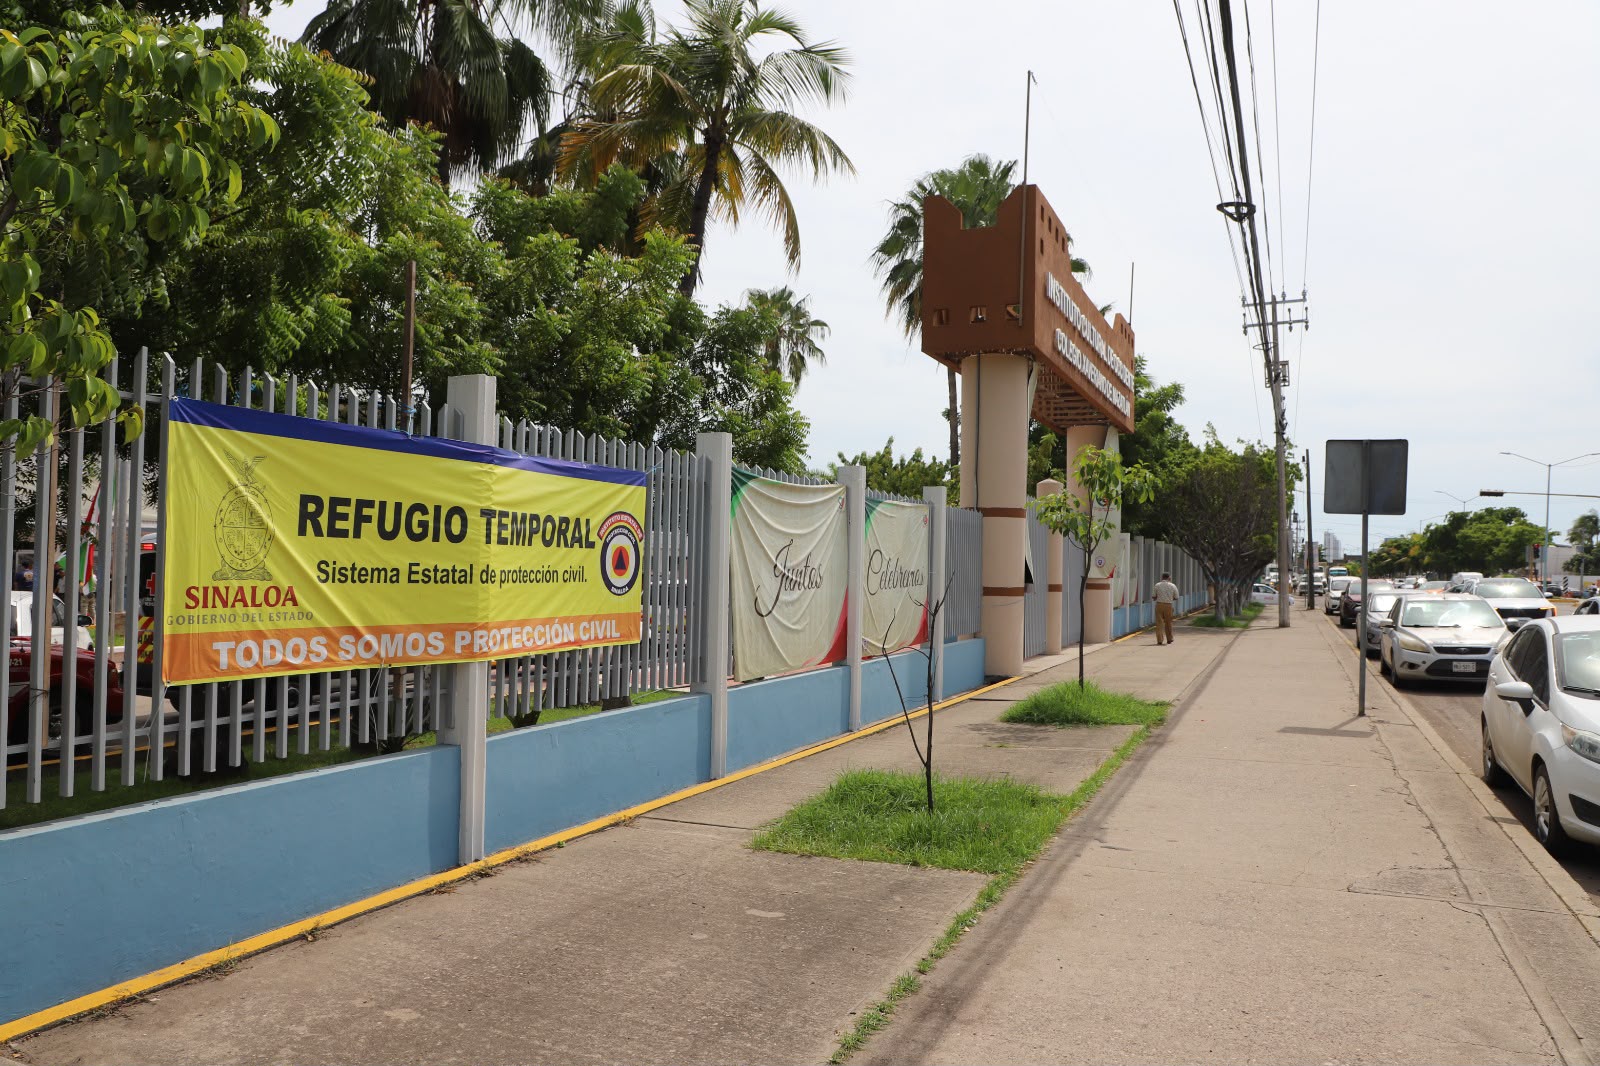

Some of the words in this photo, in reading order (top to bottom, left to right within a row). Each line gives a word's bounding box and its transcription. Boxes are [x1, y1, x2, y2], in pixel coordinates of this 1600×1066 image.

[1046, 272, 1082, 333] INSTITUTO
[1081, 315, 1107, 362] CULTURAL
[1055, 328, 1082, 371] COLEGIO
[297, 494, 469, 544] REFUGIO
[480, 508, 596, 550] TEMPORAL
[316, 560, 400, 584] Sistema
[407, 562, 474, 585] Estatal
[479, 564, 497, 585] de
[499, 564, 559, 589] protección
[562, 565, 588, 584] civil.
[166, 613, 237, 626] GOBIERNO
[241, 612, 264, 623] DEL
[268, 611, 314, 622] ESTADO
[185, 585, 299, 610] SINALOA
[212, 636, 328, 670] TODOS
[338, 630, 445, 660] SOMOS
[454, 618, 575, 654] PROTECCIÓN
[579, 619, 621, 641] CIVIL
